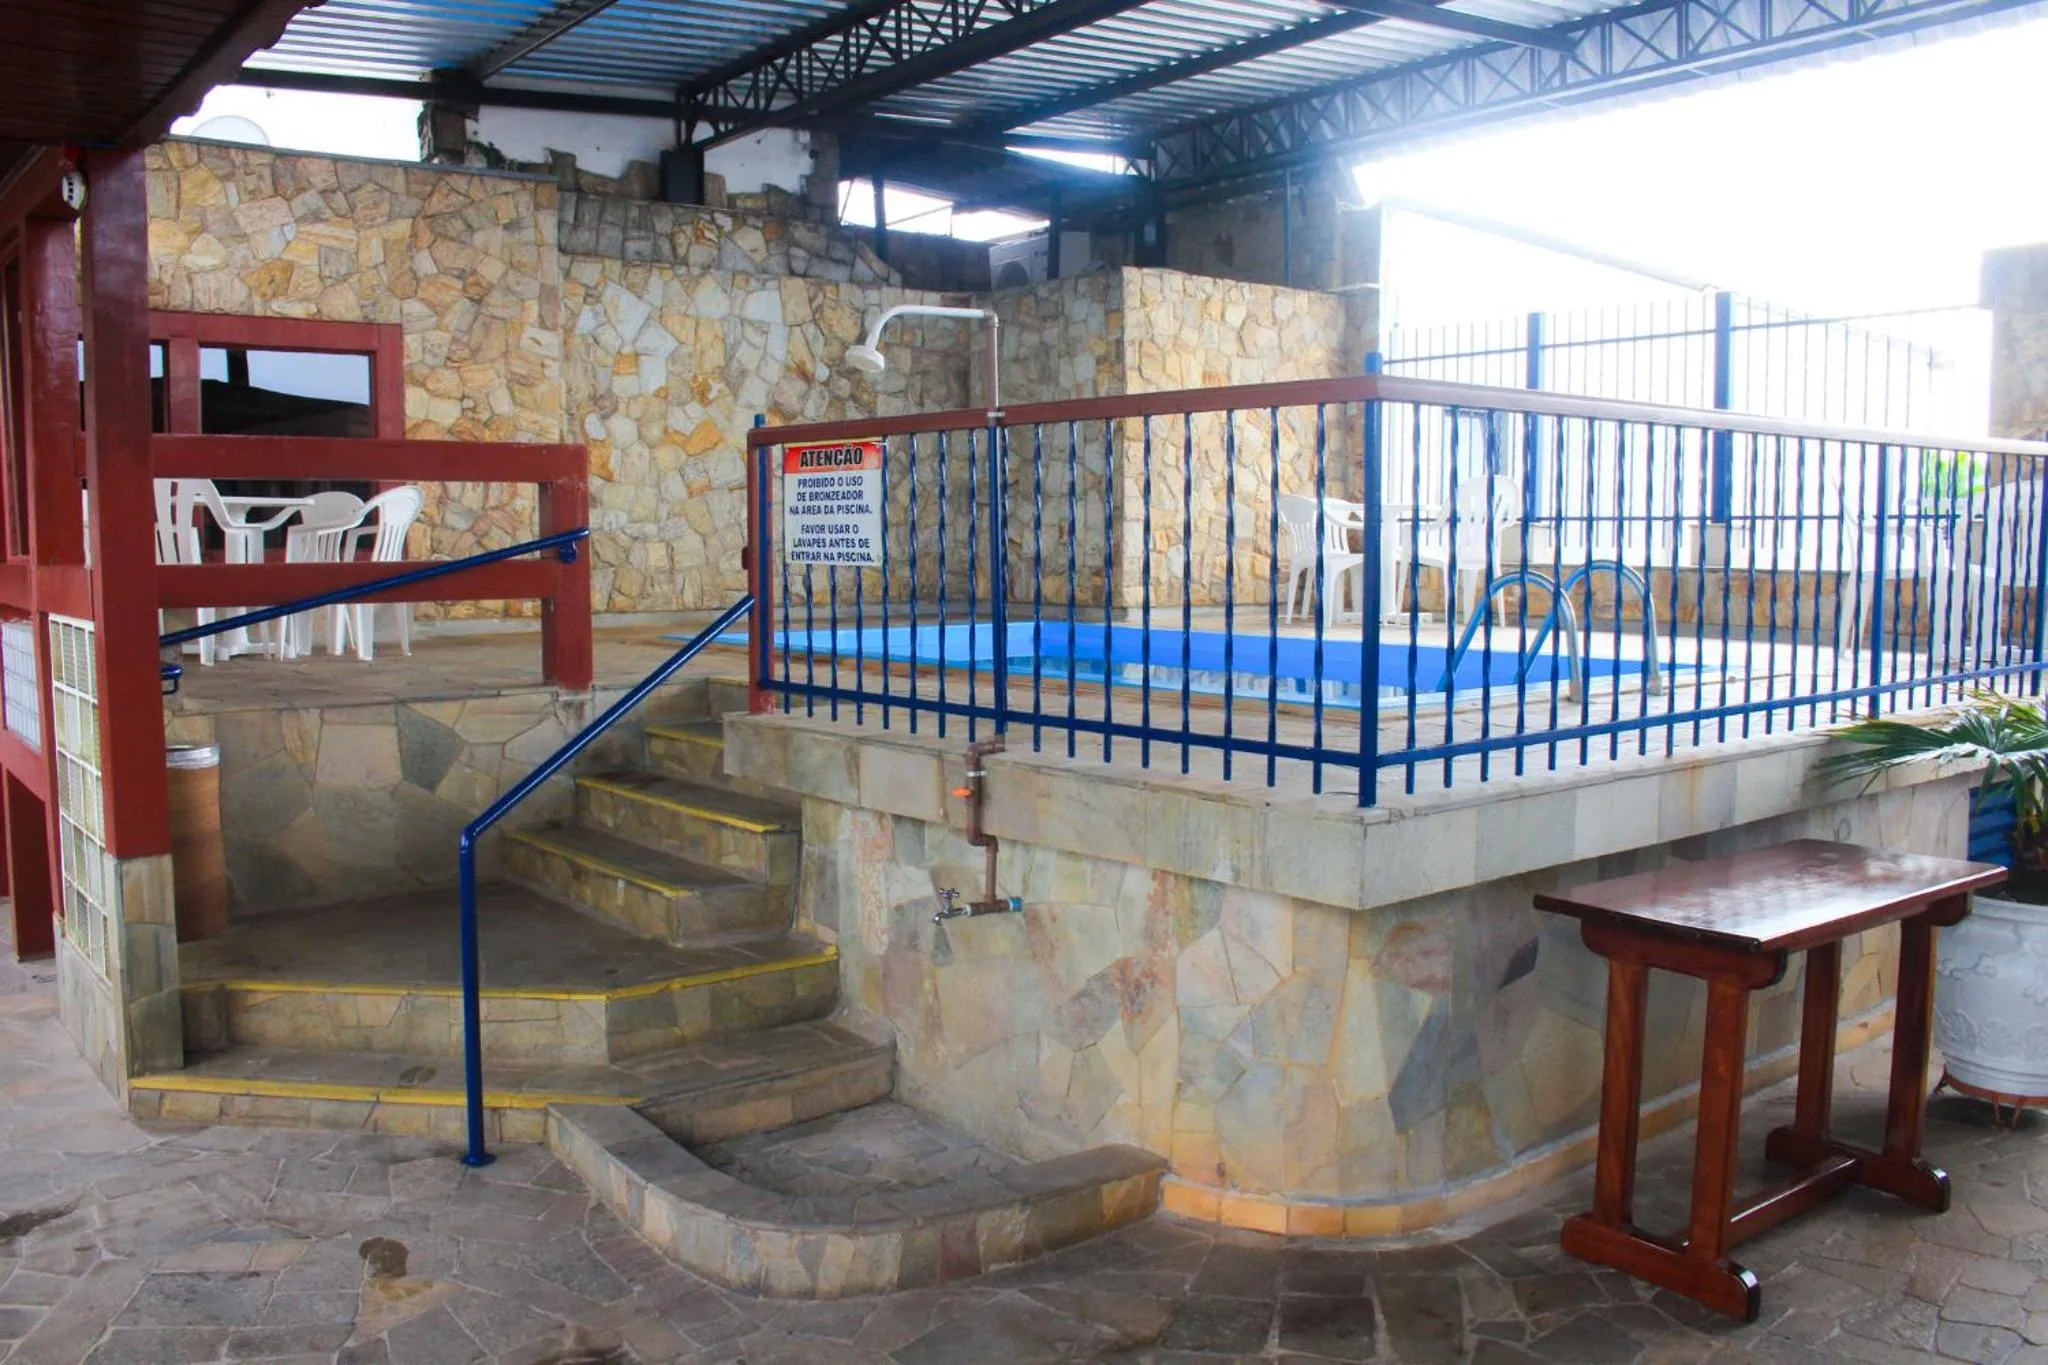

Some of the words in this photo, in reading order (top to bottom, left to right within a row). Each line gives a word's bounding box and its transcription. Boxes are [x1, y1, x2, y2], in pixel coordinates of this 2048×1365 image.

[797, 477, 835, 488] PROIBIDO
[837, 476, 844, 487] O
[845, 476, 864, 487] USO
[797, 491, 807, 502] DE
[809, 490, 864, 501] BRONZEADOR
[789, 505, 799, 515] NA
[824, 504, 835, 514] DA
[837, 504, 873, 514] PISCINA.
[801, 524, 826, 534] FAVOR
[828, 524, 850, 534] USAR
[852, 524, 859, 534] O
[829, 538, 856, 548] ANTES
[858, 538, 870, 548] DE
[791, 551, 821, 561] ENTRAR
[823, 551, 835, 561] NA
[837, 551, 874, 562] PISCINA.
